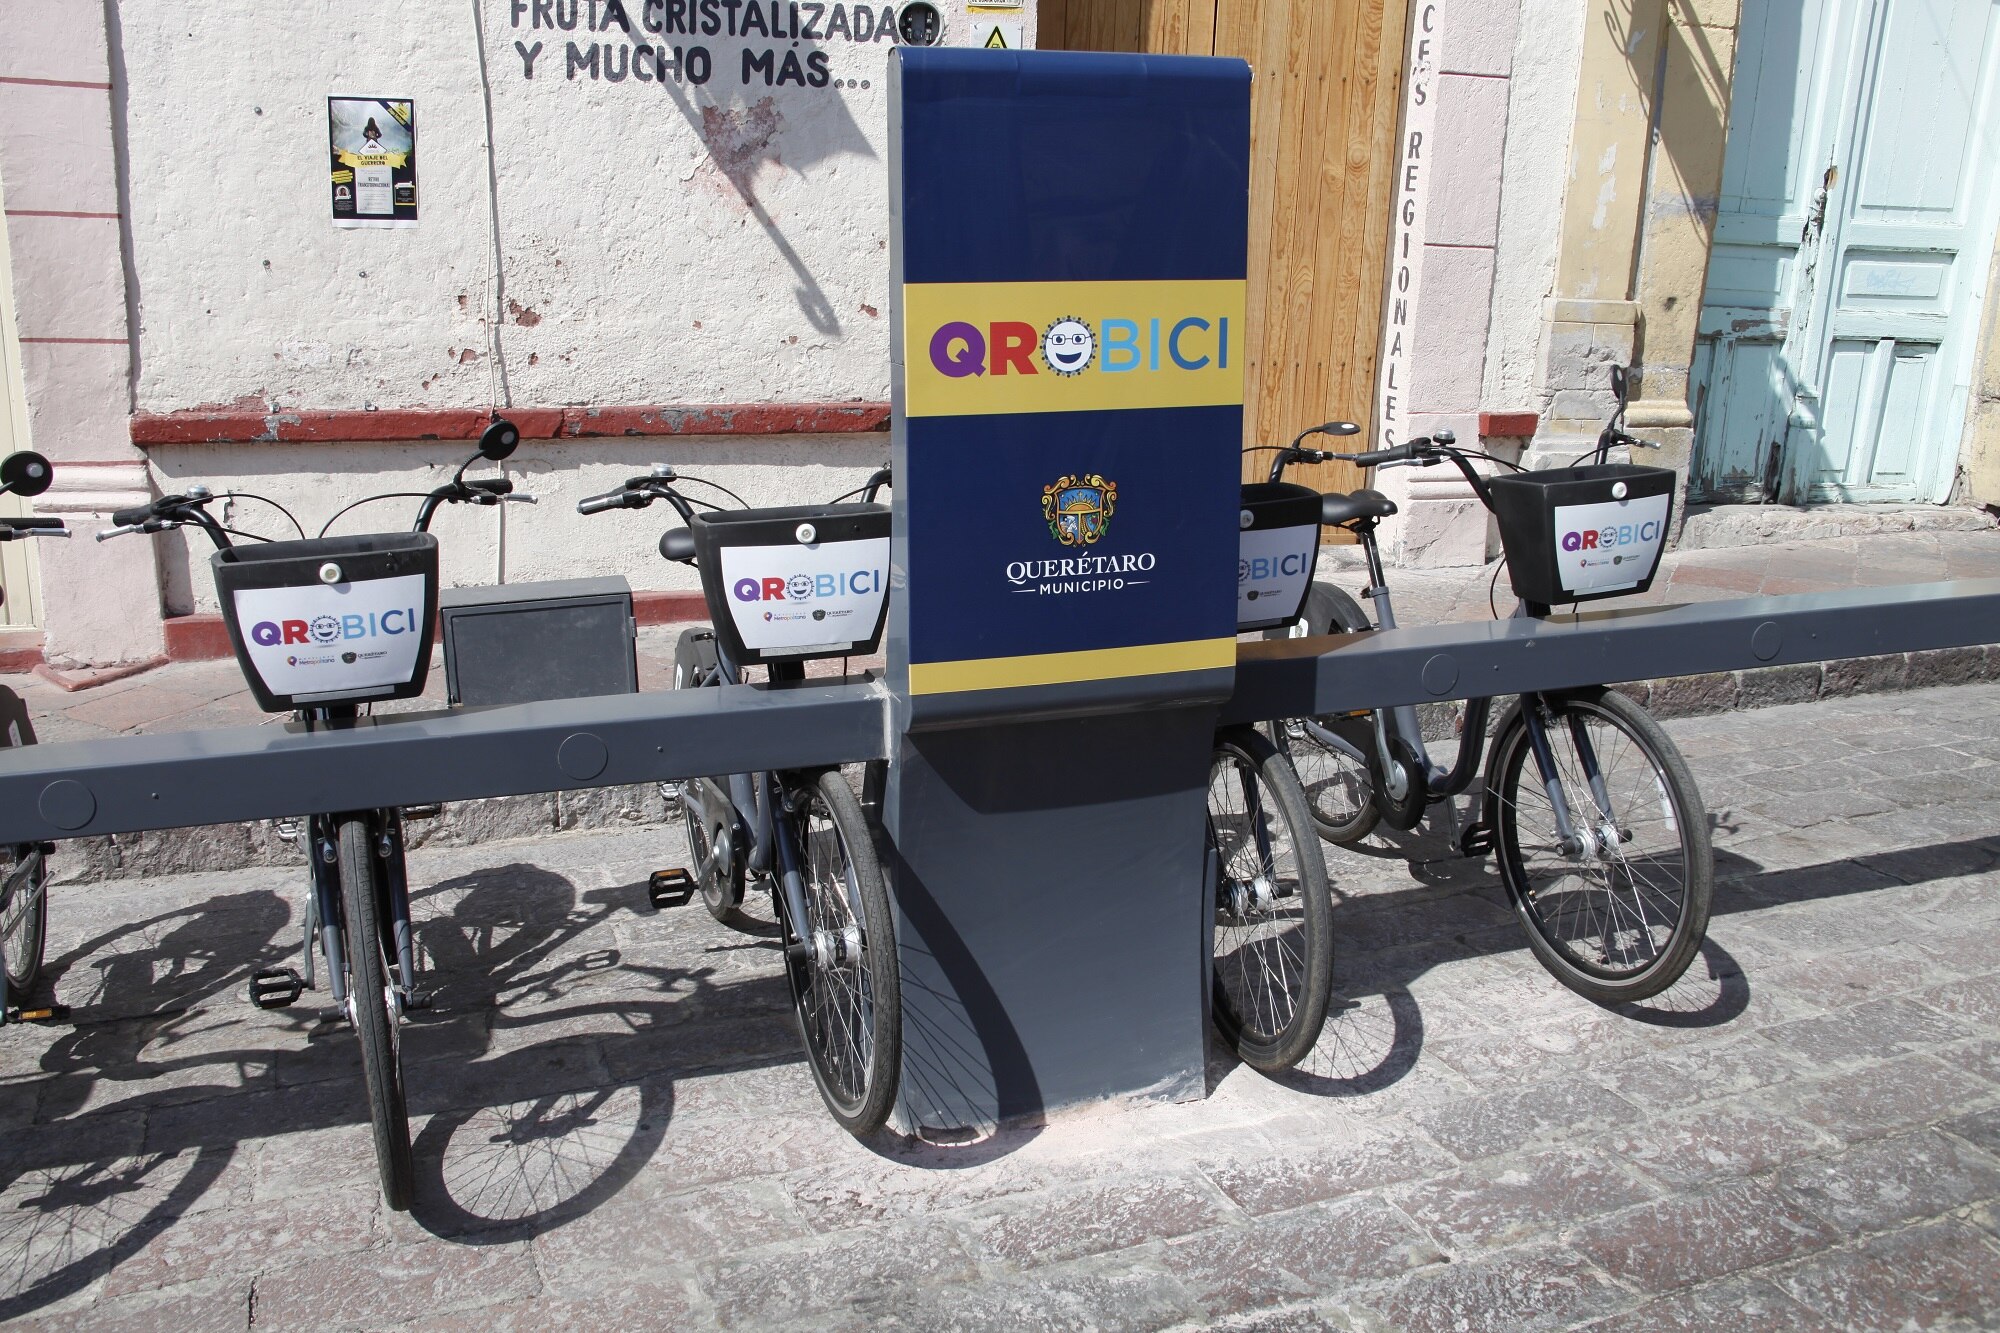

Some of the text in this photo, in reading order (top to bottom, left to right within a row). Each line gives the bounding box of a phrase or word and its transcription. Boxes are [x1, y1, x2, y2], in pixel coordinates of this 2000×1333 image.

[510, 0, 900, 44] FRUTA CRISTALIZADA
[514, 41, 543, 80] Y
[566, 40, 712, 86] MUCHO
[1383, 131, 1423, 452] REGIONALES
[1006, 551, 1156, 585] QUERÉTARO
[1039, 578, 1124, 595] MUNICIPIO
